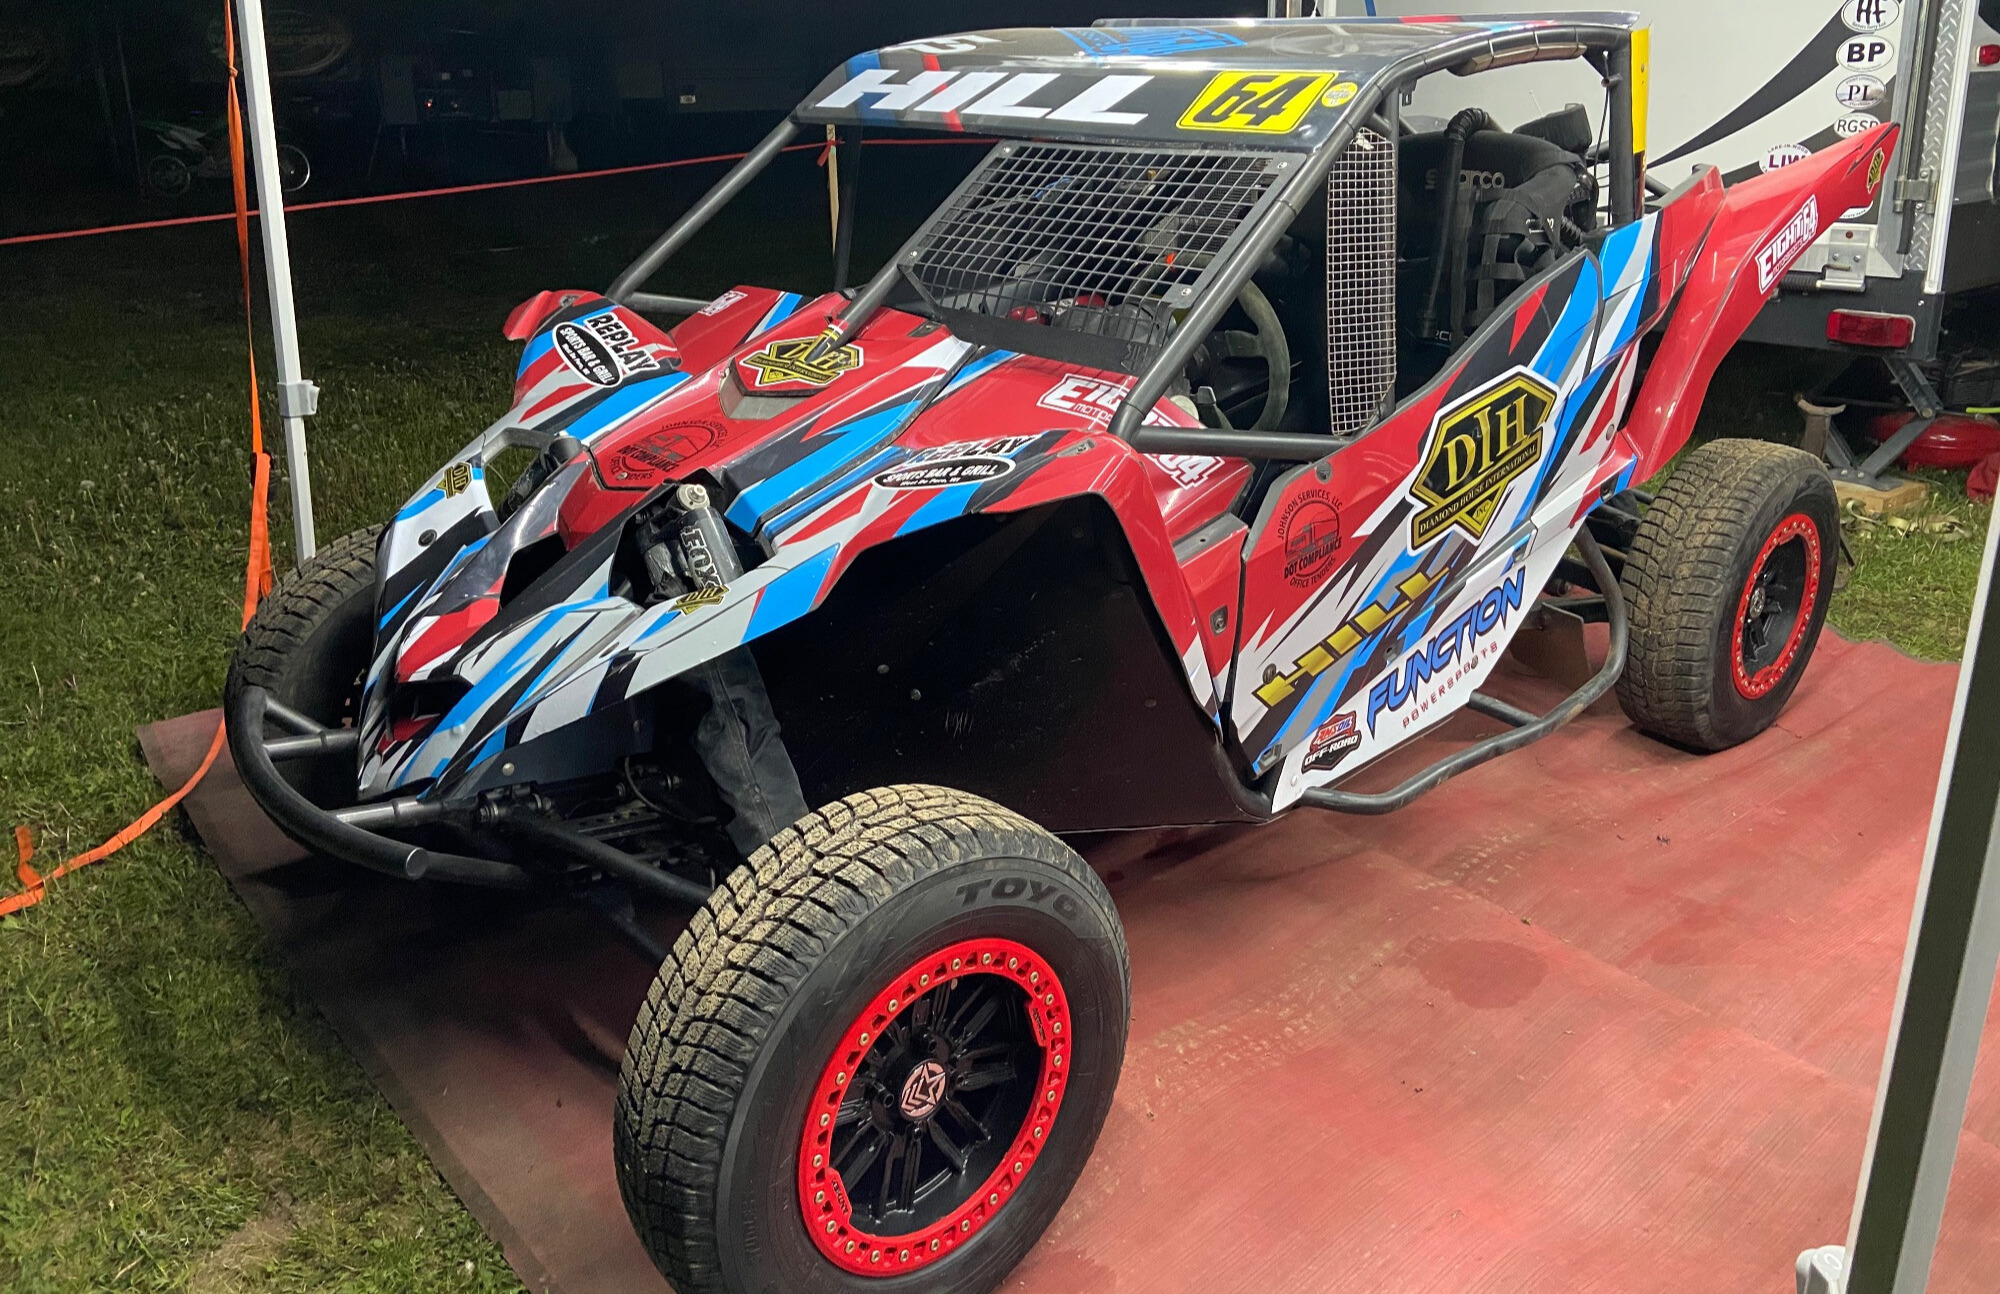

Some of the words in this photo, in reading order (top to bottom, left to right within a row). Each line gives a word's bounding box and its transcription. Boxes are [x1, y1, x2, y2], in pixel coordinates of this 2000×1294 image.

[1847, 42, 1886, 63] BP
[815, 69, 1155, 125] HILL
[1193, 75, 1322, 127] 64
[1848, 84, 1874, 101] PL
[1424, 168, 1505, 190] sarco
[560, 327, 587, 350] SPORTS
[577, 346, 597, 362] BAR
[587, 314, 656, 373] REPLAY
[587, 359, 601, 368] &
[593, 365, 616, 384] GRILL
[1443, 393, 1528, 491] DIH
[883, 469, 928, 484] SPORTS
[926, 467, 949, 479] BAR
[949, 466, 962, 477] &
[961, 464, 999, 477] GRILL
[1420, 500, 1460, 534] DIAMOND
[1460, 483, 1485, 508] HOUSE
[1485, 444, 1537, 489] INTERNATIONAL
[1278, 499, 1299, 540] JOHNSON
[1298, 489, 1332, 503] SERVICES,
[1331, 496, 1343, 511] LLC
[681, 527, 723, 592] FOX
[1284, 560, 1299, 579] DOT
[1298, 537, 1342, 571] COMPLIANCE
[1289, 576, 1311, 589] OFFICE
[1310, 556, 1336, 585] TENDERS
[1366, 566, 1527, 741] FUNCTION
[1402, 640, 1498, 730] POWERSPOTS
[1312, 716, 1353, 745] AMSOIL
[1304, 734, 1359, 766] OFF-ROAD
[955, 876, 1084, 920] TOYO
